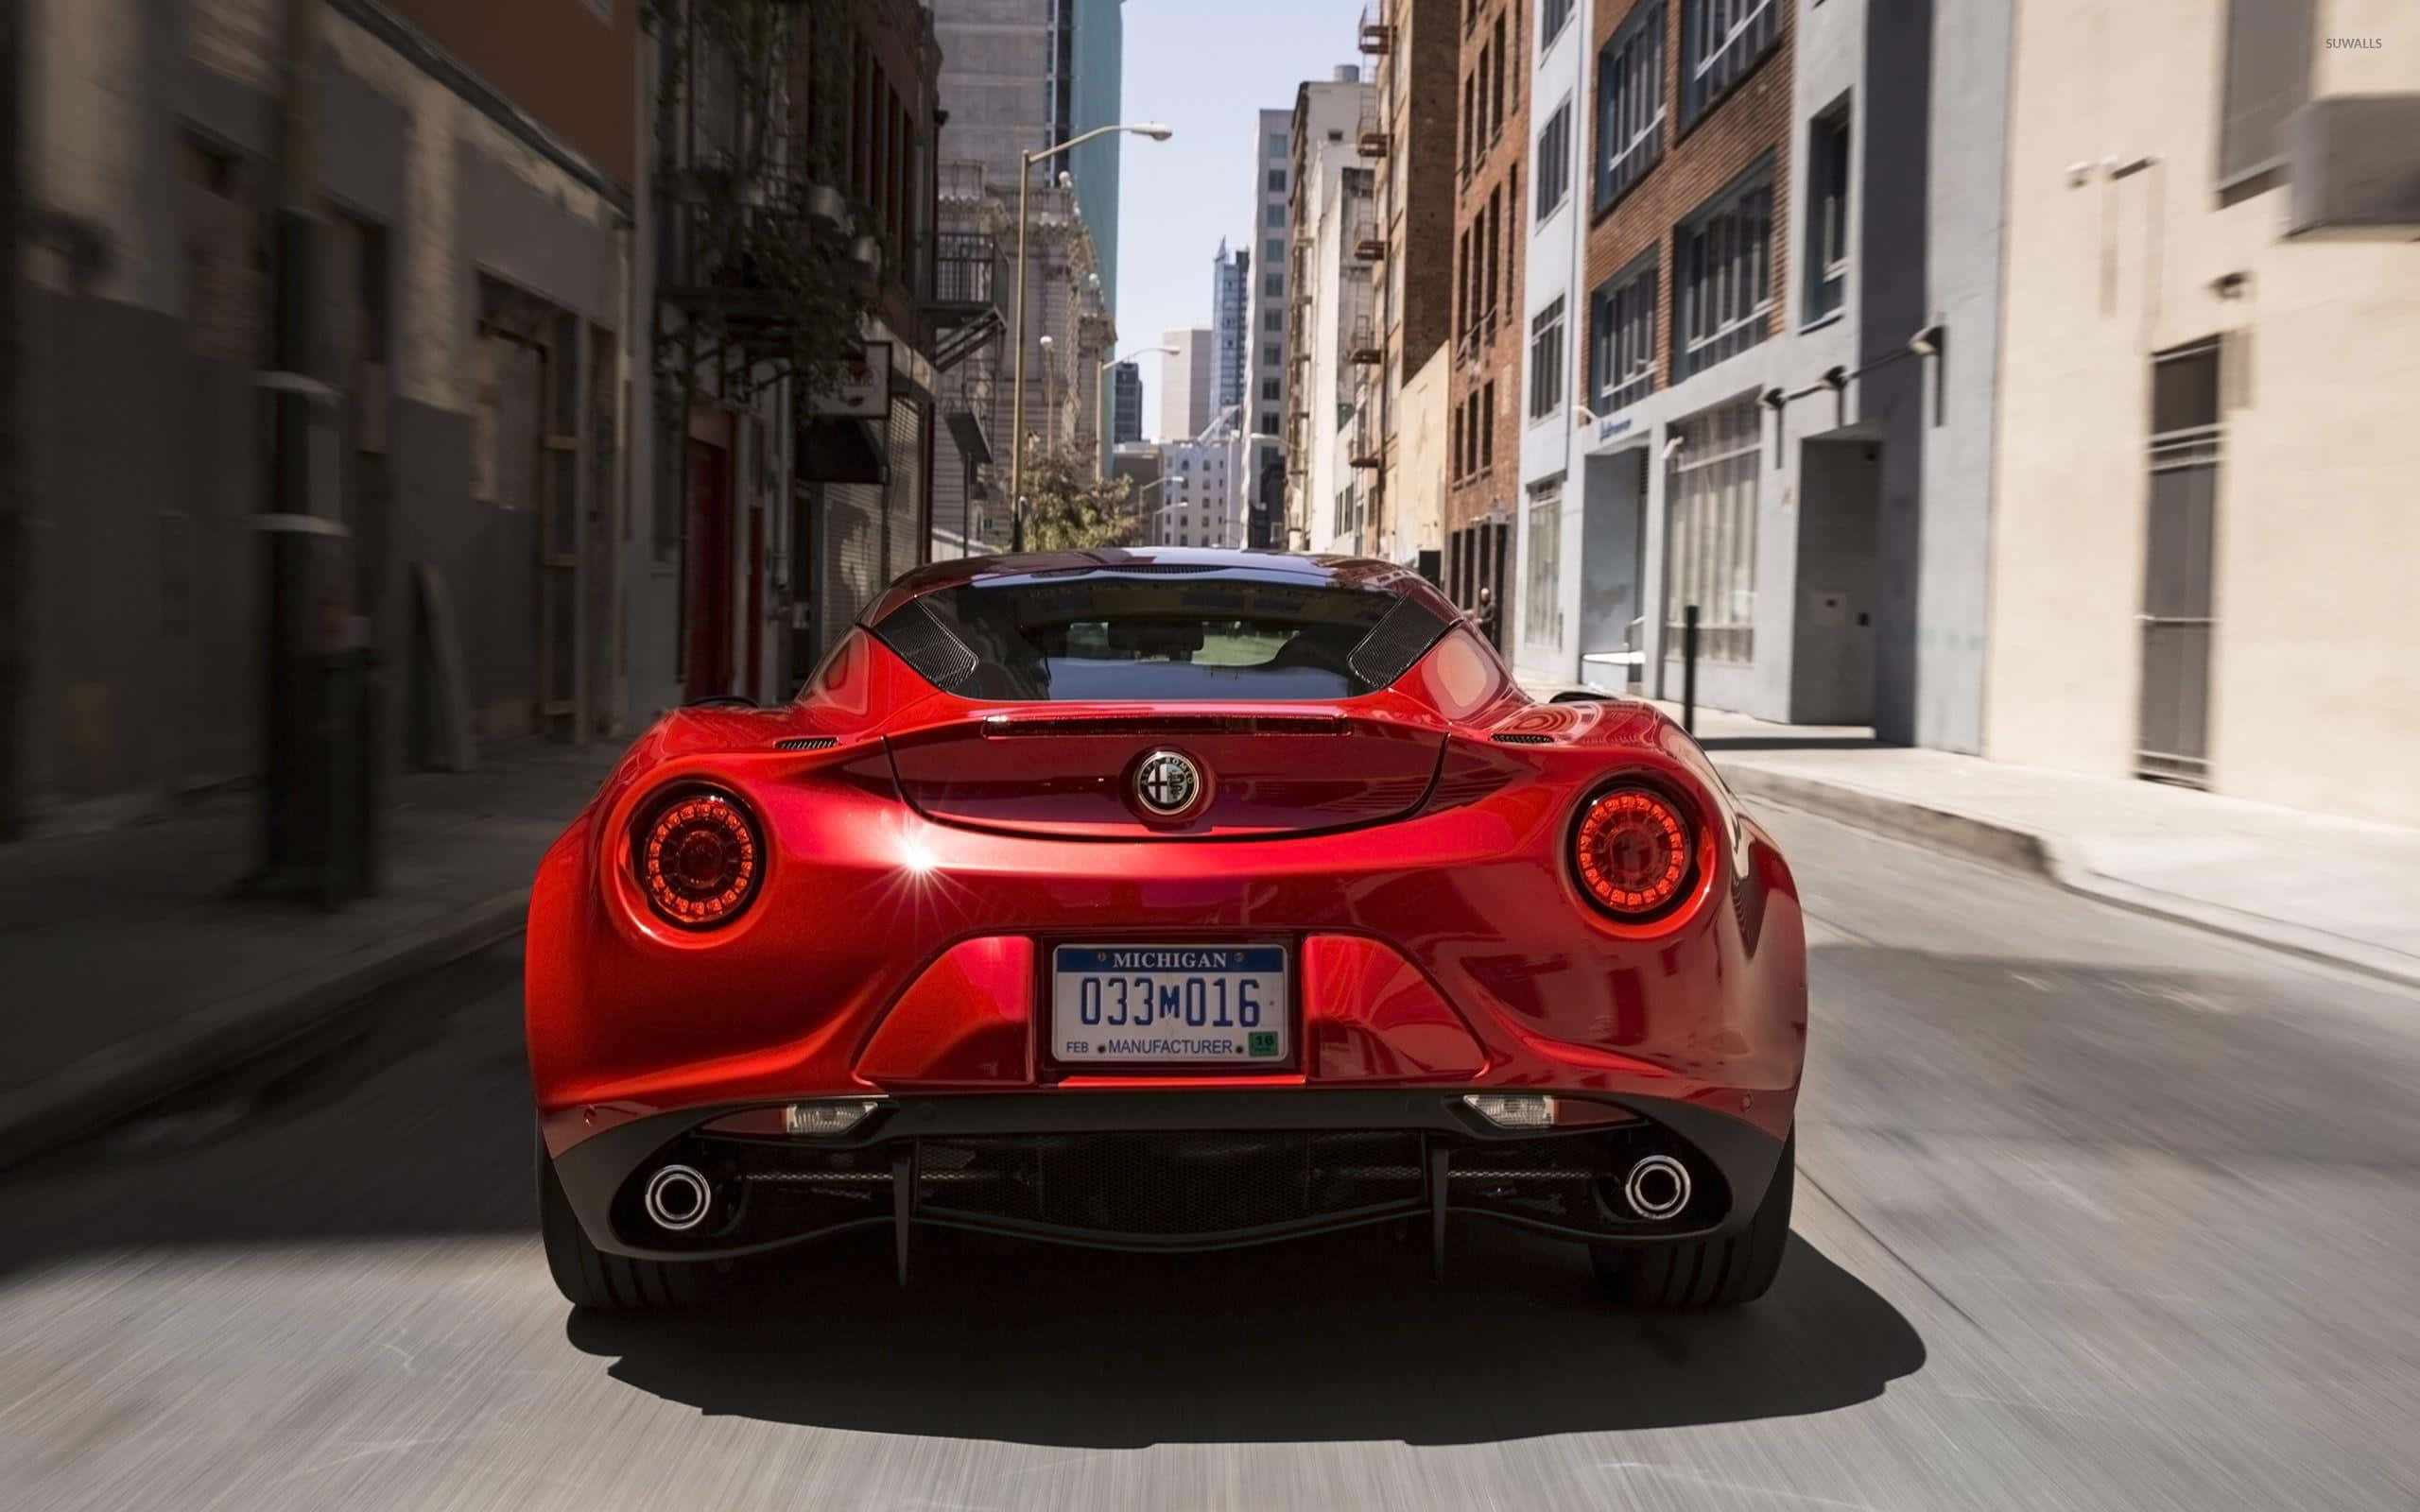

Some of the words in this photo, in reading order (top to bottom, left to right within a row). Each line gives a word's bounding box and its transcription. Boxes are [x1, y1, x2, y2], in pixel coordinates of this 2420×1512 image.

[1113, 953, 1227, 968] MICHIGAN
[1080, 977, 1260, 1027] 033M016
[1066, 1042, 1090, 1053] FEB
[1109, 1040, 1233, 1054] MANUFACTURER
